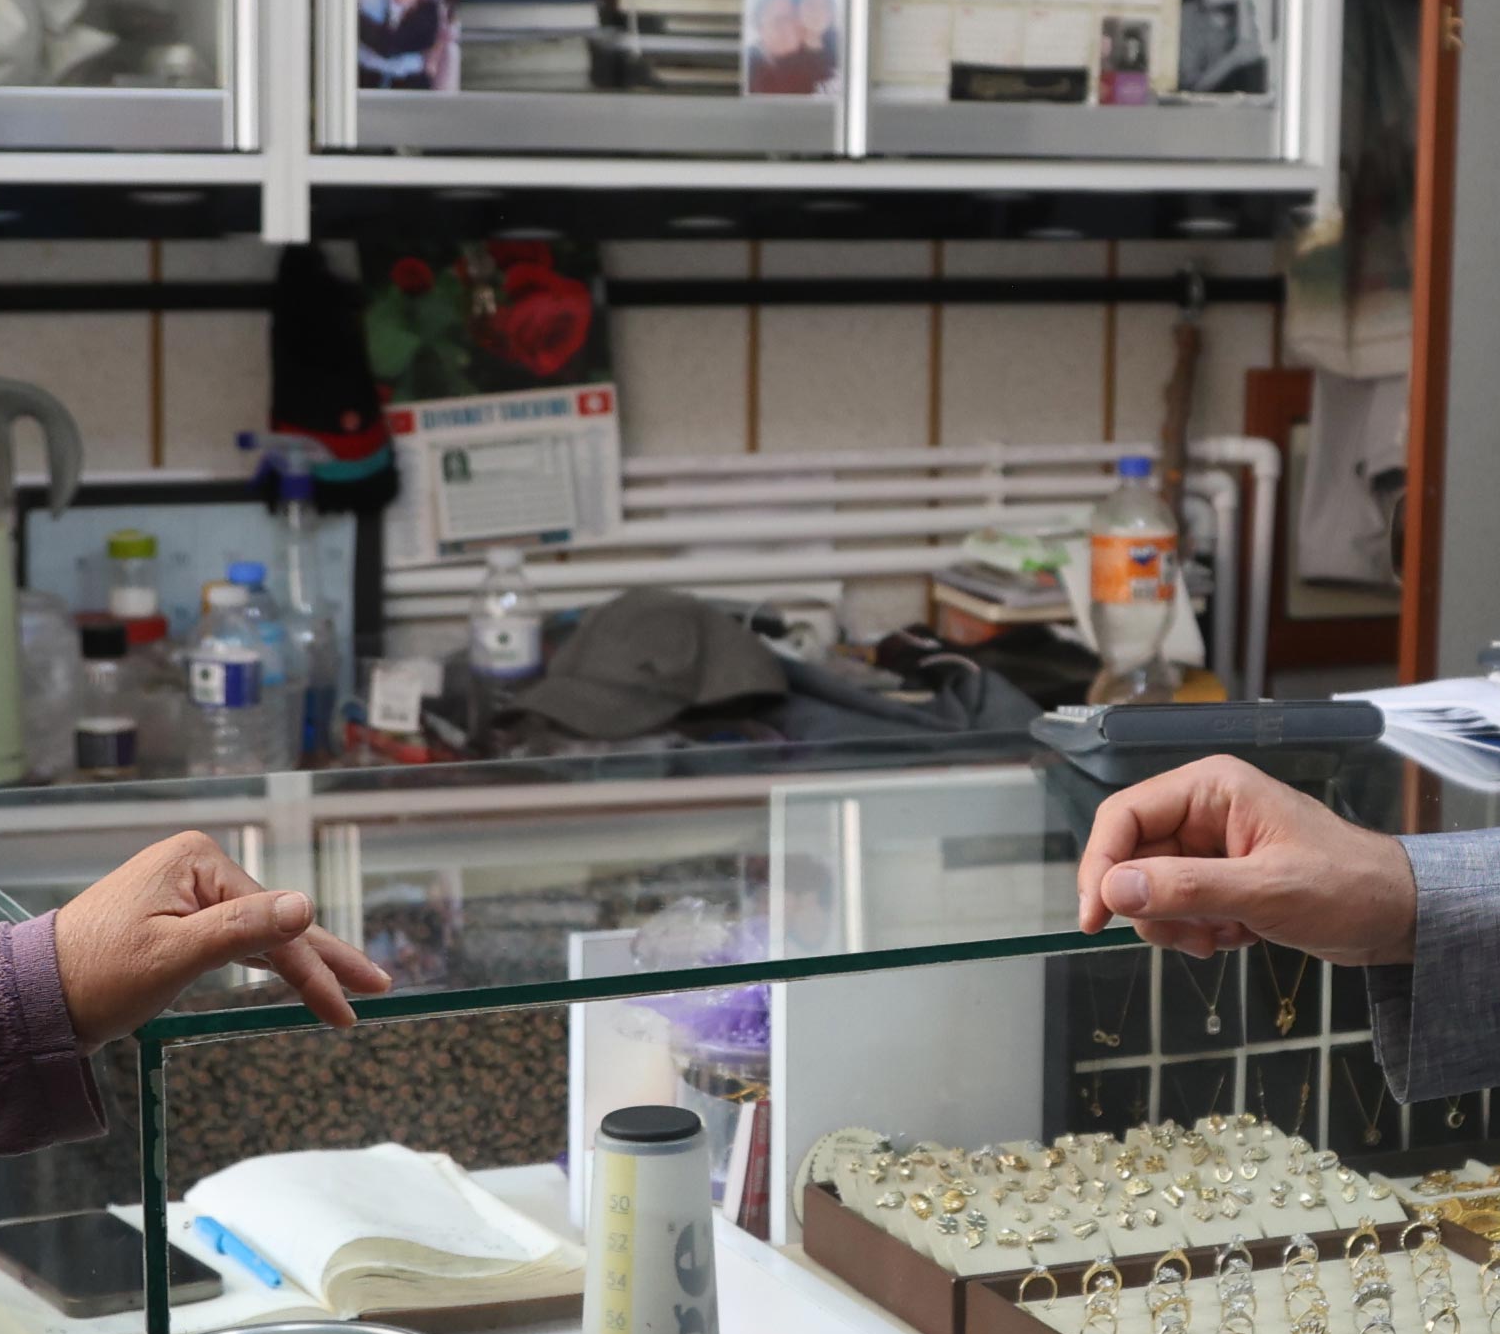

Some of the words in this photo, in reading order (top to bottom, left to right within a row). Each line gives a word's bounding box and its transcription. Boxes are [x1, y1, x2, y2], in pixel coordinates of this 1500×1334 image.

[610, 1195, 630, 1213] 50
[607, 1233, 628, 1251] 52
[606, 1272, 627, 1290] 54
[605, 1310, 626, 1329] 56
